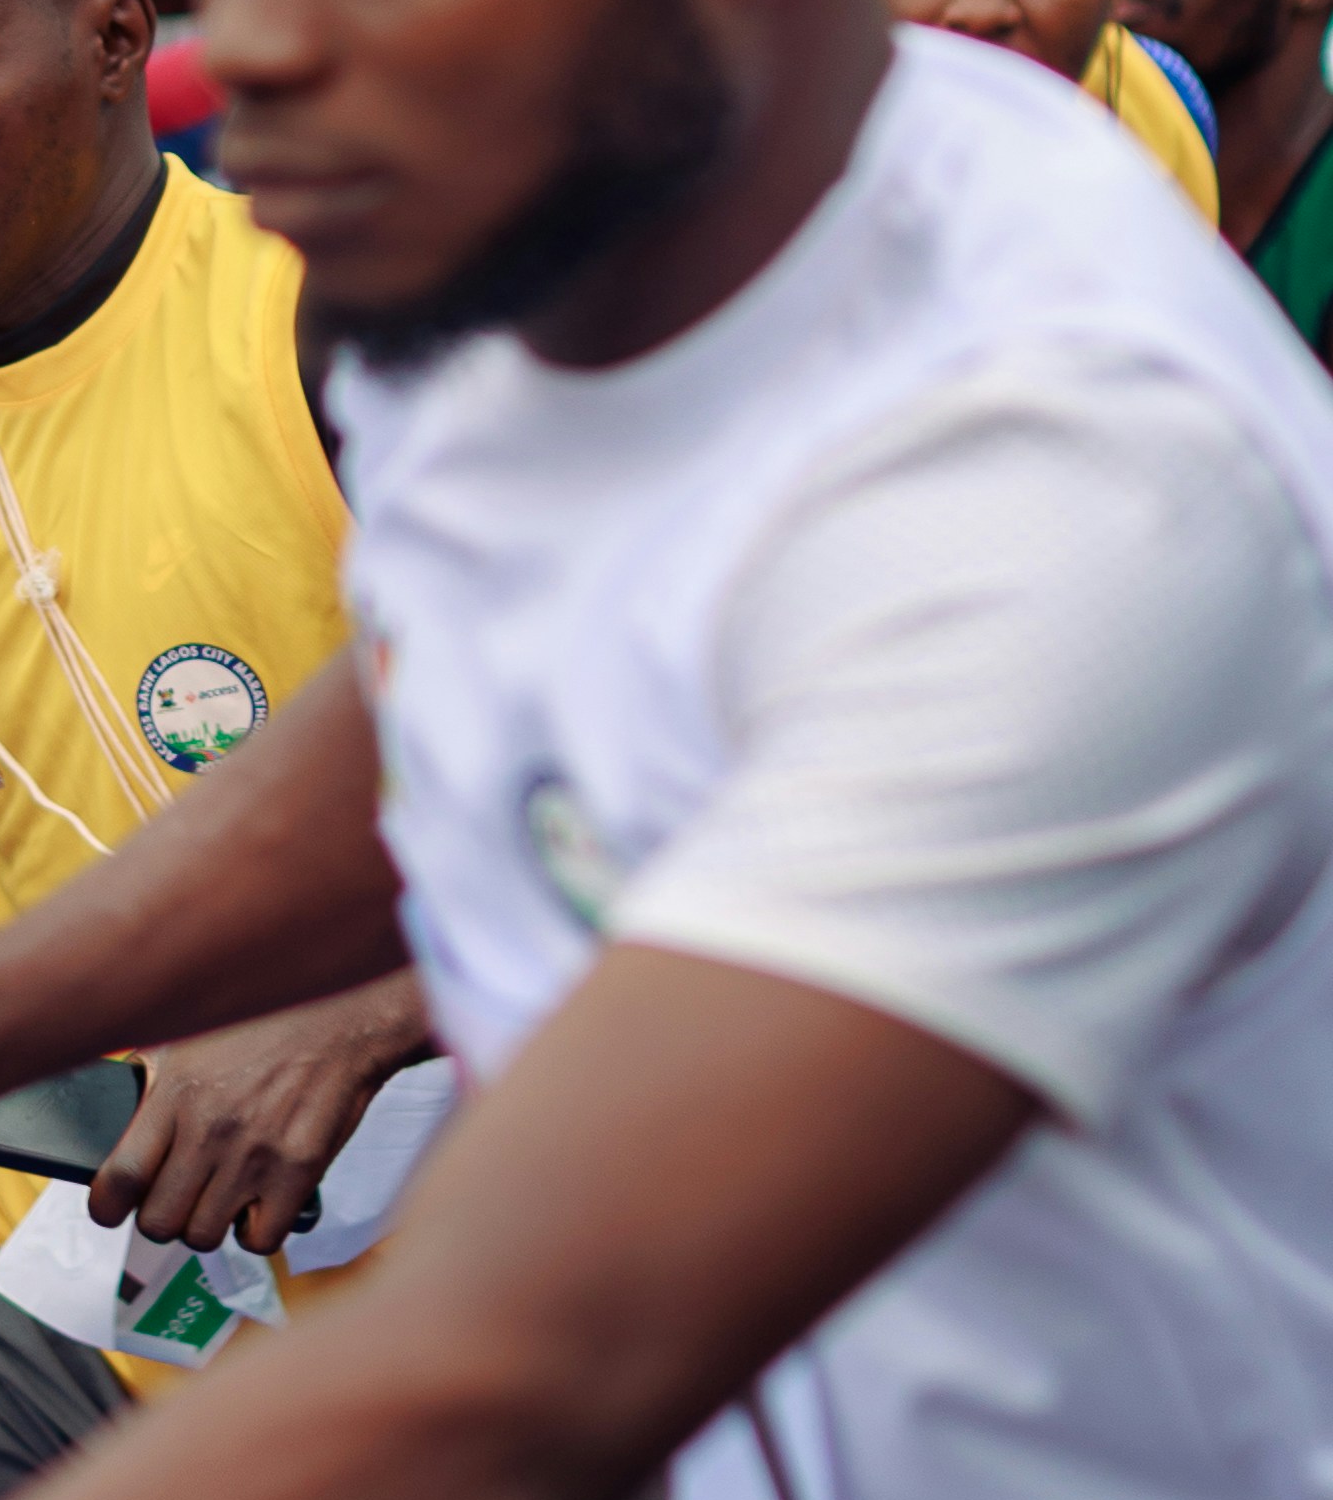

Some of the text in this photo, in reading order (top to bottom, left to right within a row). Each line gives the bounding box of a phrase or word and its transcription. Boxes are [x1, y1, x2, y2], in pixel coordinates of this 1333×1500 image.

[138, 670, 158, 712] BANK
[152, 645, 200, 673] LAGOS
[201, 646, 235, 666] CITY
[232, 661, 269, 731] MARATHO
